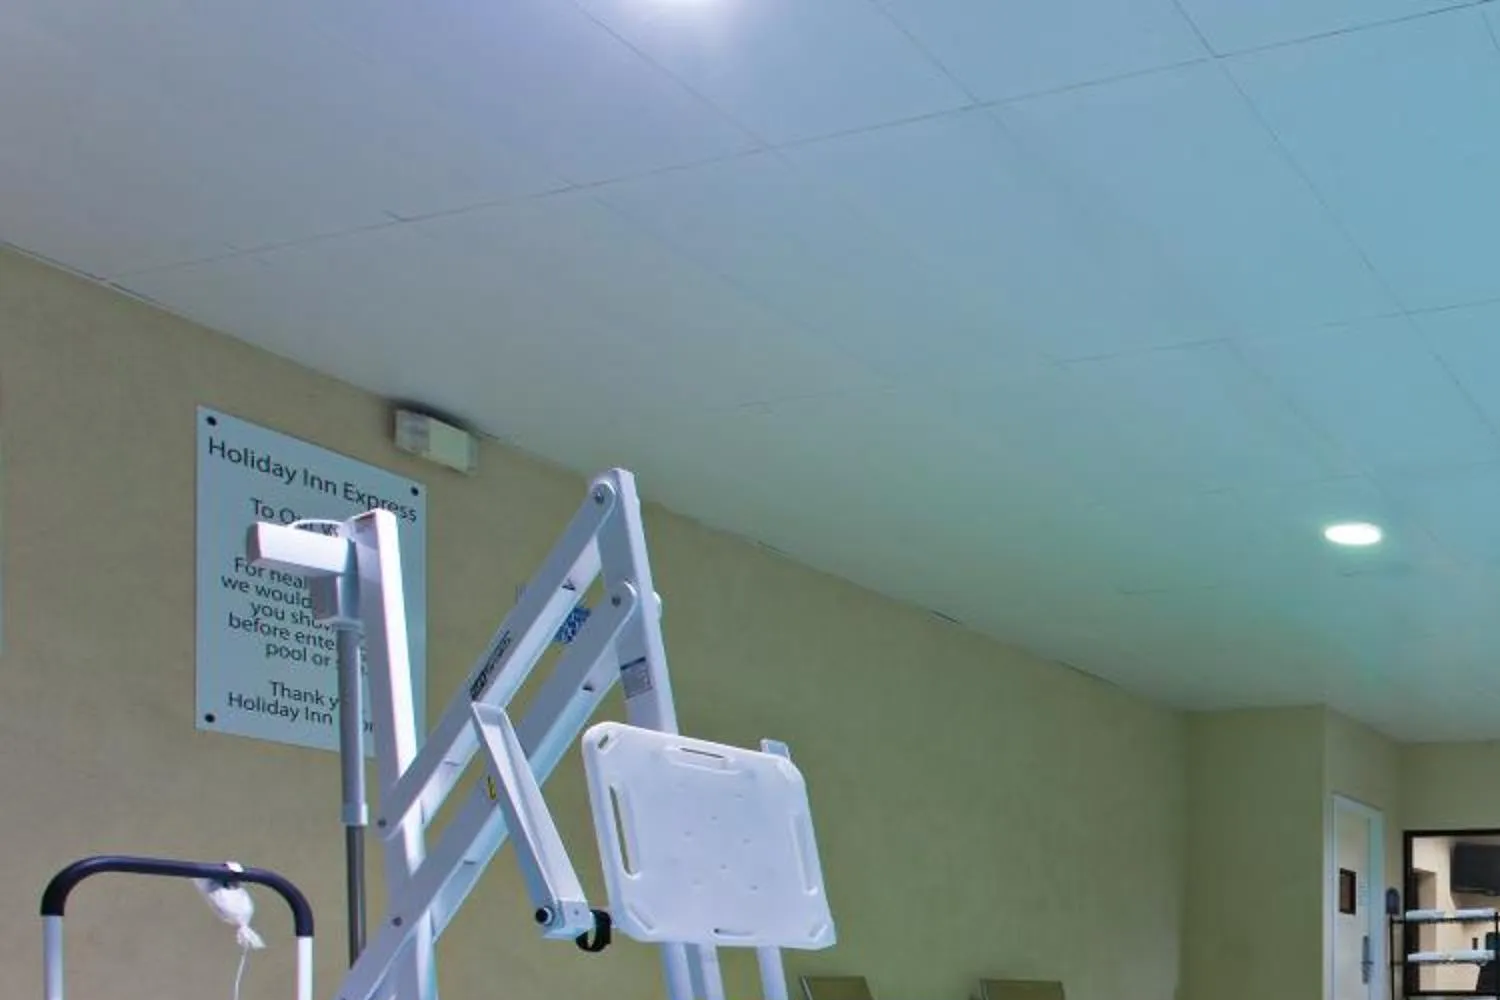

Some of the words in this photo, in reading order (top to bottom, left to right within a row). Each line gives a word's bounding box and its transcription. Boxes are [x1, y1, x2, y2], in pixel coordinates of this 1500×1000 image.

[208, 436, 297, 485] Holiday
[303, 467, 337, 496] Inn
[344, 482, 417, 523] Express
[250, 497, 275, 520] To
[234, 557, 266, 577] For
[221, 575, 249, 593] we
[250, 602, 285, 620] you
[228, 612, 290, 641] before
[265, 643, 308, 663] pool
[312, 653, 331, 667] or
[269, 680, 325, 706] Thank
[228, 691, 300, 722] Holiday
[305, 708, 333, 725] Inn
